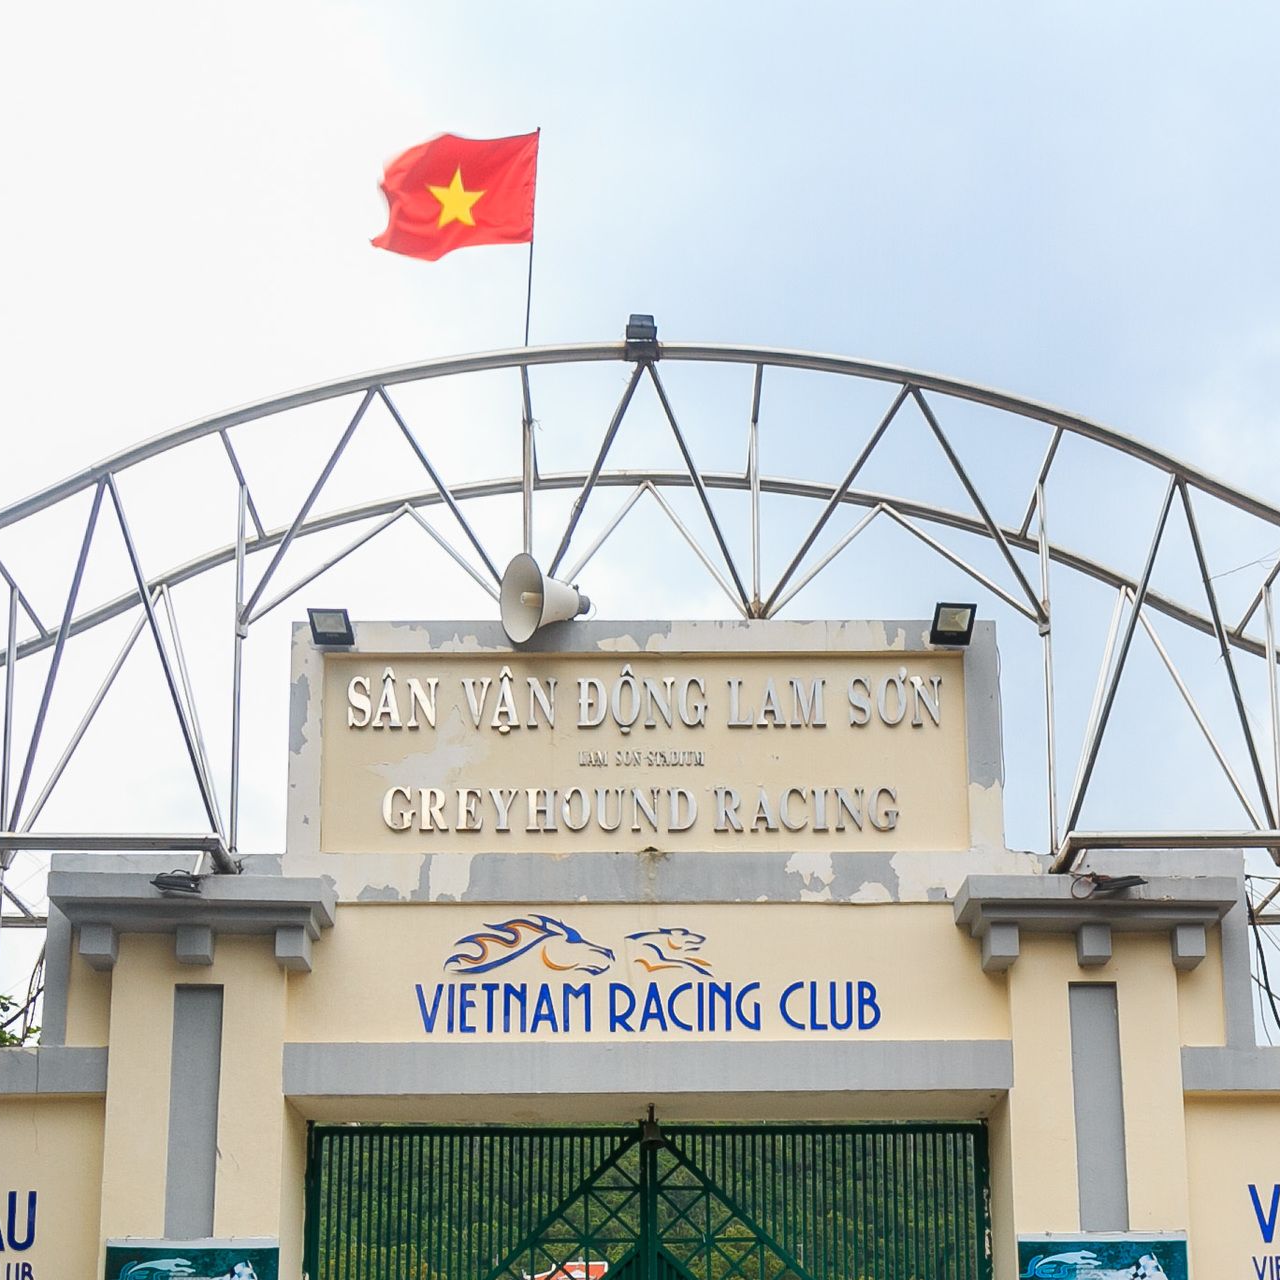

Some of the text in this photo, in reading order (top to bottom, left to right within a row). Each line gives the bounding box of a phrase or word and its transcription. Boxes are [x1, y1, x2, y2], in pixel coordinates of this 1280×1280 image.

[347, 663, 942, 734] SÂN VẬN ĐỘNG LAM SƠN
[579, 750, 609, 767] LAM
[615, 750, 642, 767] SON
[382, 786, 900, 833] GREYHOUND RACING
[415, 981, 881, 1034] VIETNAM RACING CLUB
